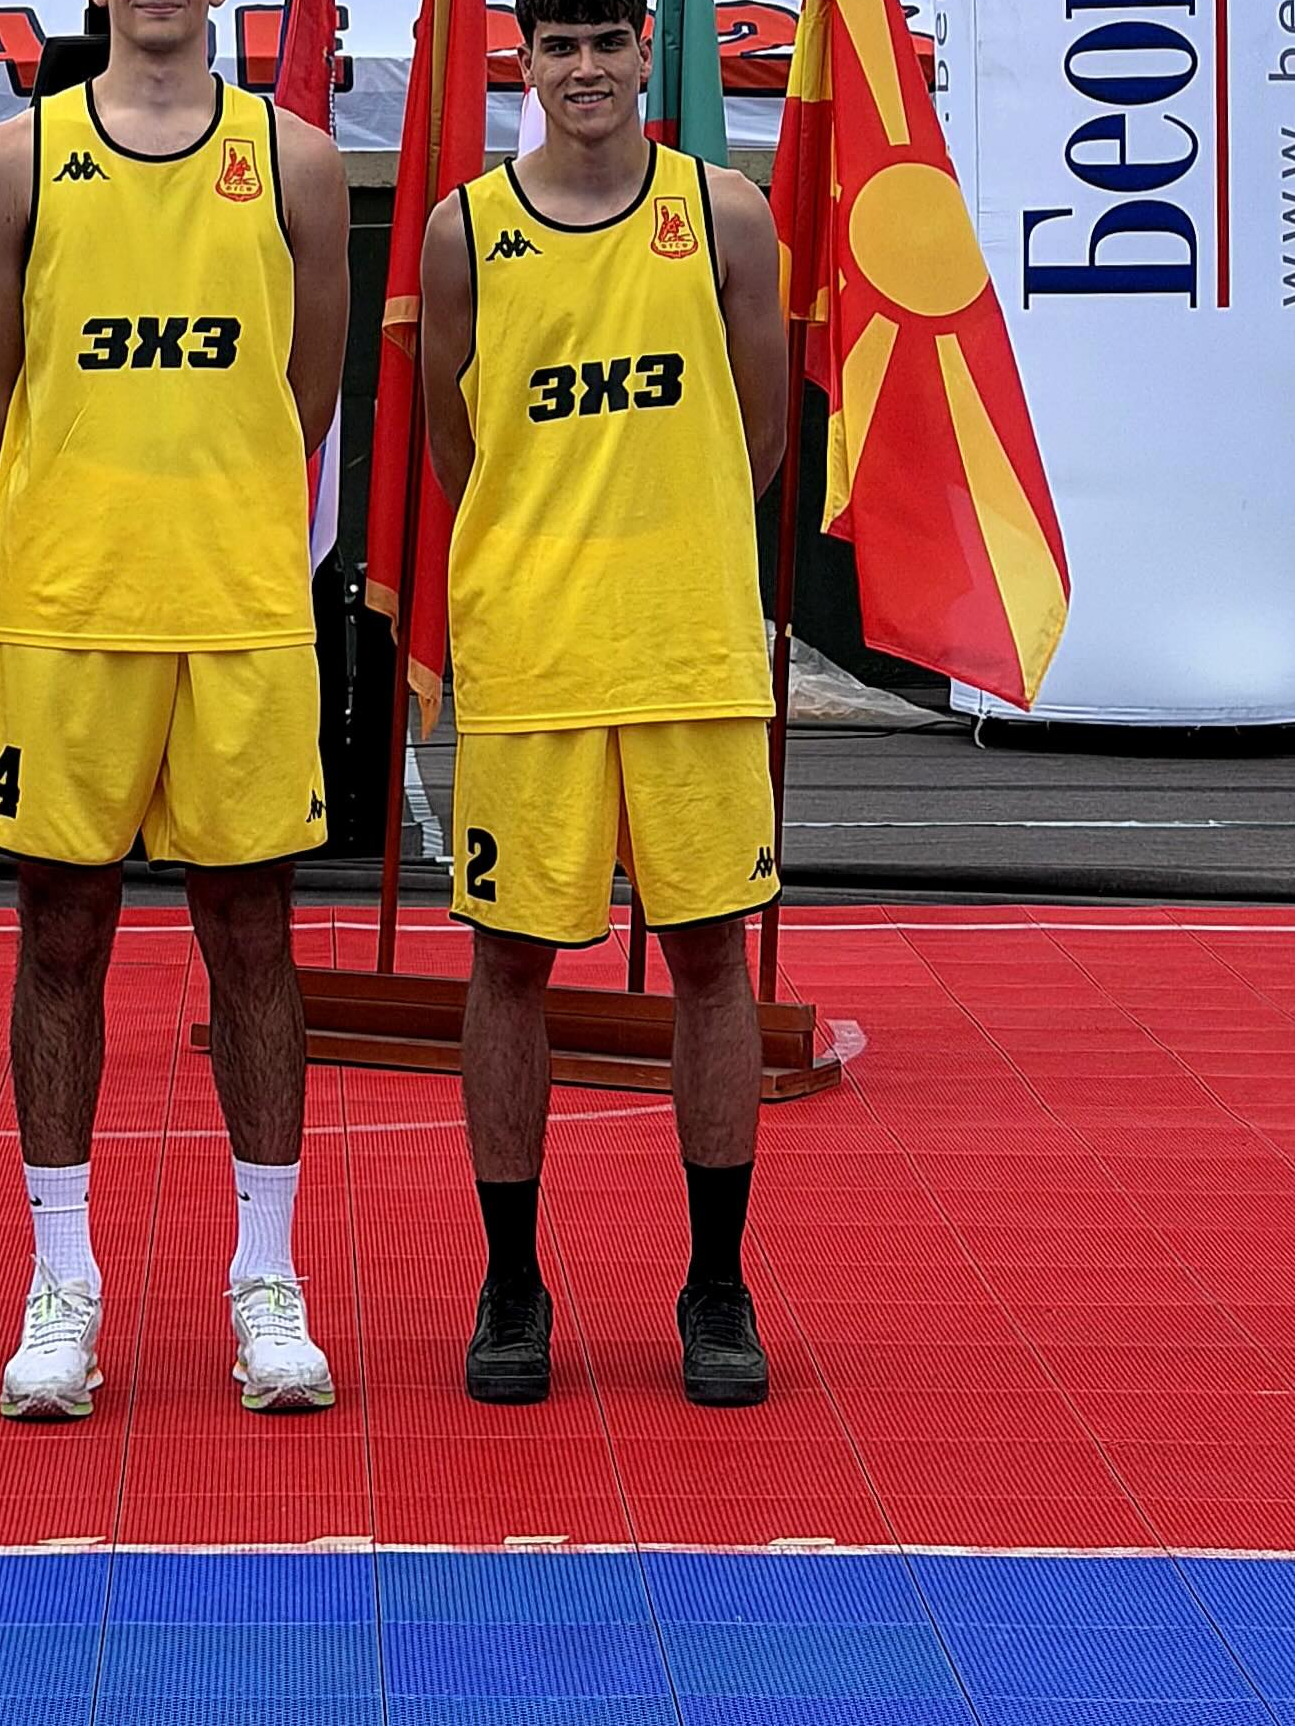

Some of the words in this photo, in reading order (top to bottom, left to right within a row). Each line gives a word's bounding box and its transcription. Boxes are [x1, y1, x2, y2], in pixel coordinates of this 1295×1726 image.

[77, 316, 242, 371] 3X3
[528, 352, 686, 424] 3X3
[466, 826, 499, 904] 2
